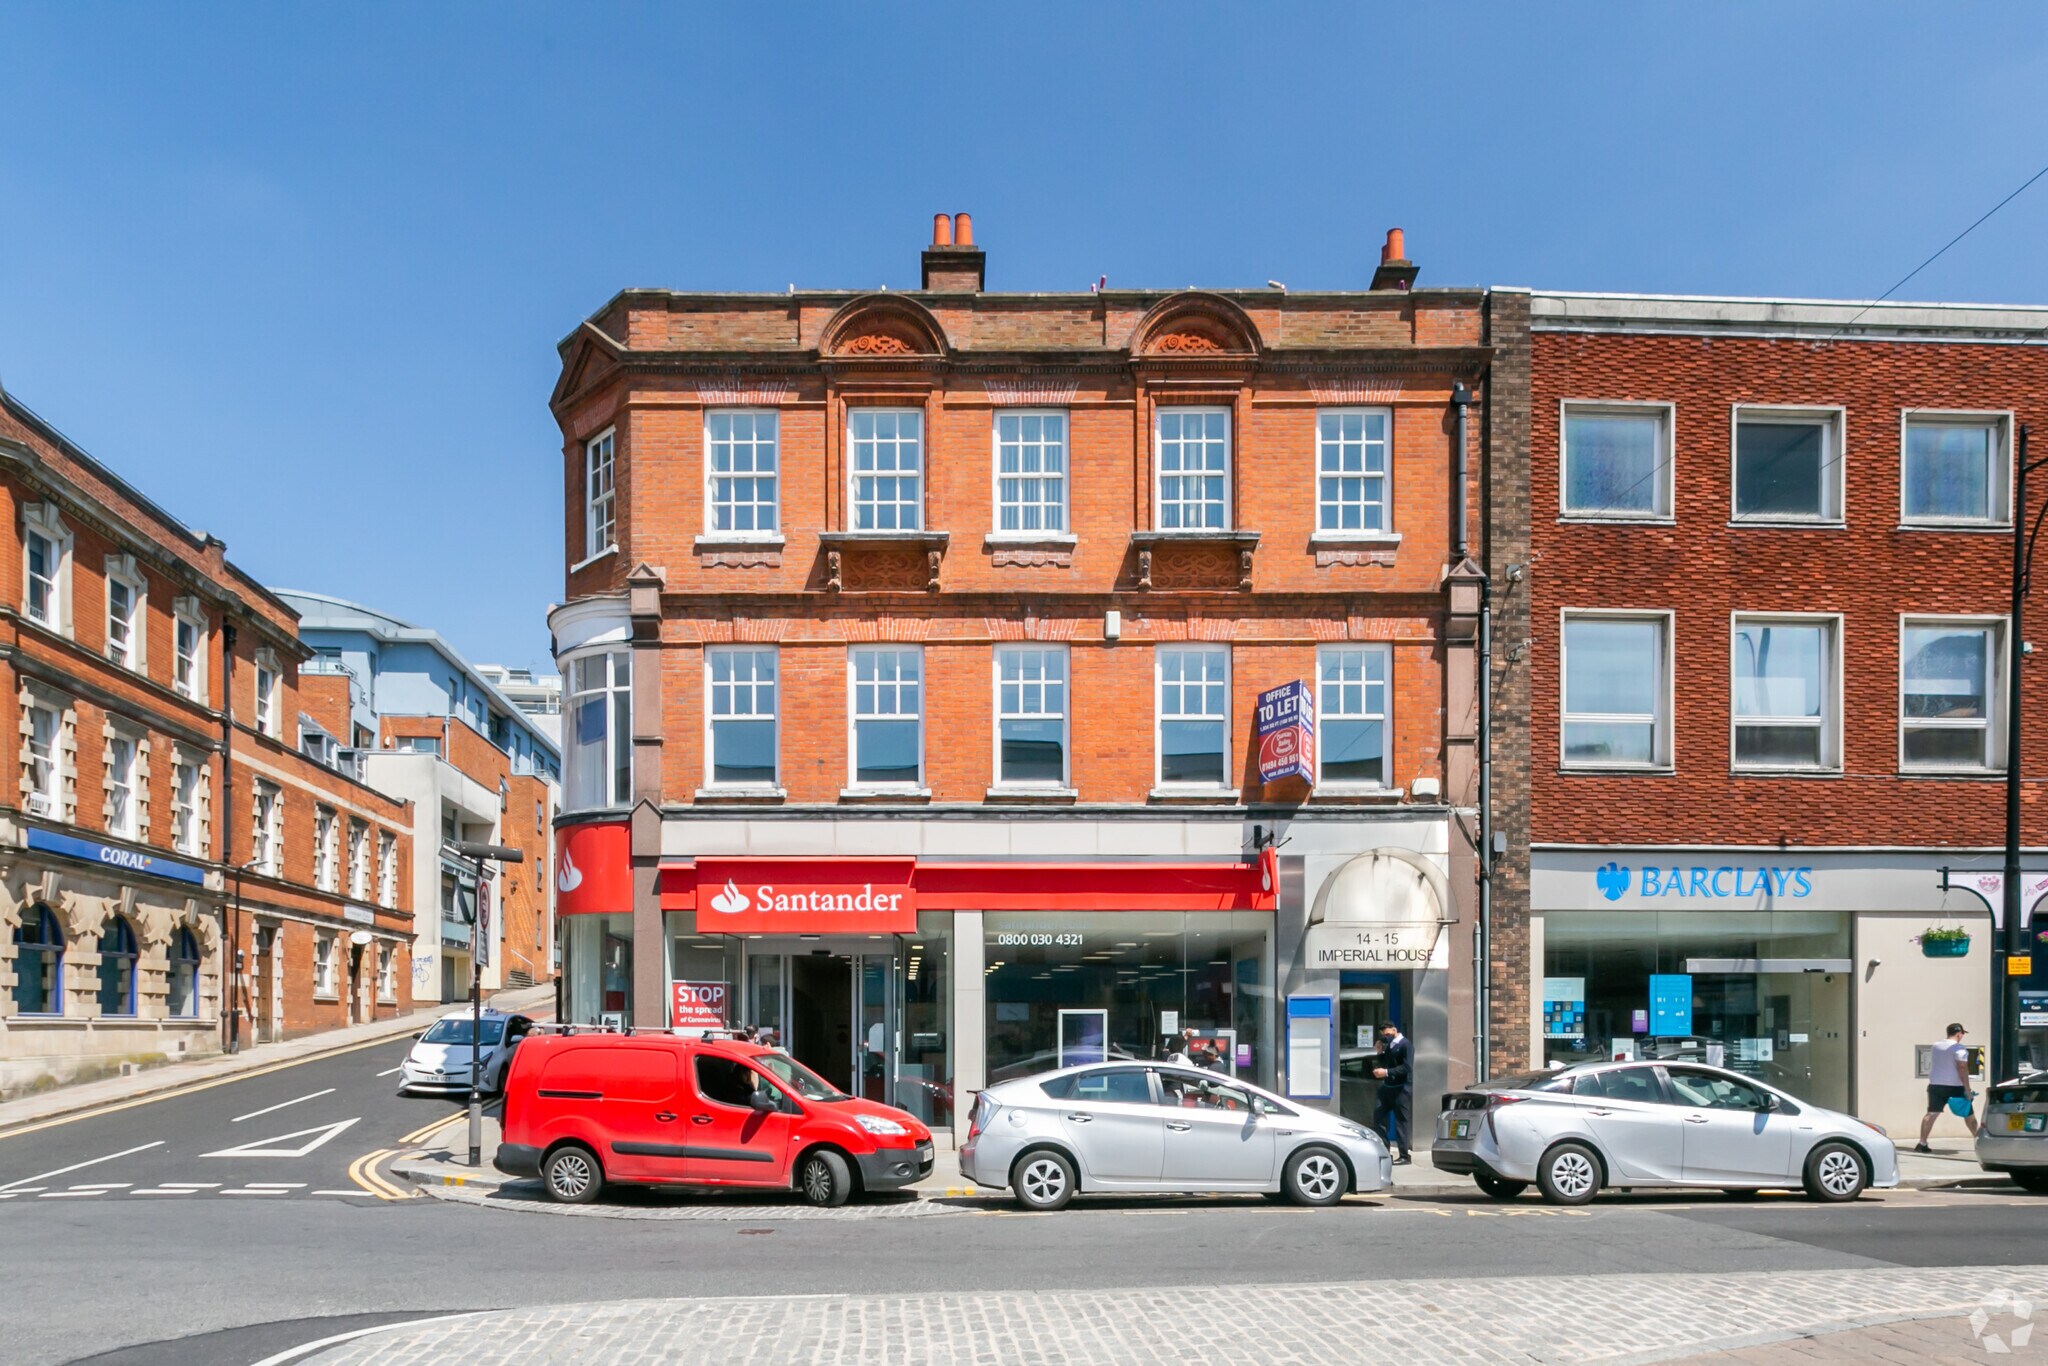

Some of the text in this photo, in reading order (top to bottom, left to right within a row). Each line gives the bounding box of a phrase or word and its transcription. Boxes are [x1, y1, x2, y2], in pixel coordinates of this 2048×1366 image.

[1266, 686, 1291, 702] OFFICE
[1259, 704, 1273, 722] TO
[1277, 695, 1299, 717] LET
[101, 847, 145, 870] CORAL
[1640, 866, 1812, 898] BARCLAYS
[757, 883, 902, 912] Santander
[998, 933, 1083, 945] 0800 030 4321
[1356, 933, 1370, 945] 14
[1384, 933, 1399, 945] 15
[1318, 949, 1434, 962] IMPERIAL HOUSE
[678, 985, 724, 1003] STOP
[679, 1005, 723, 1015] the spread
